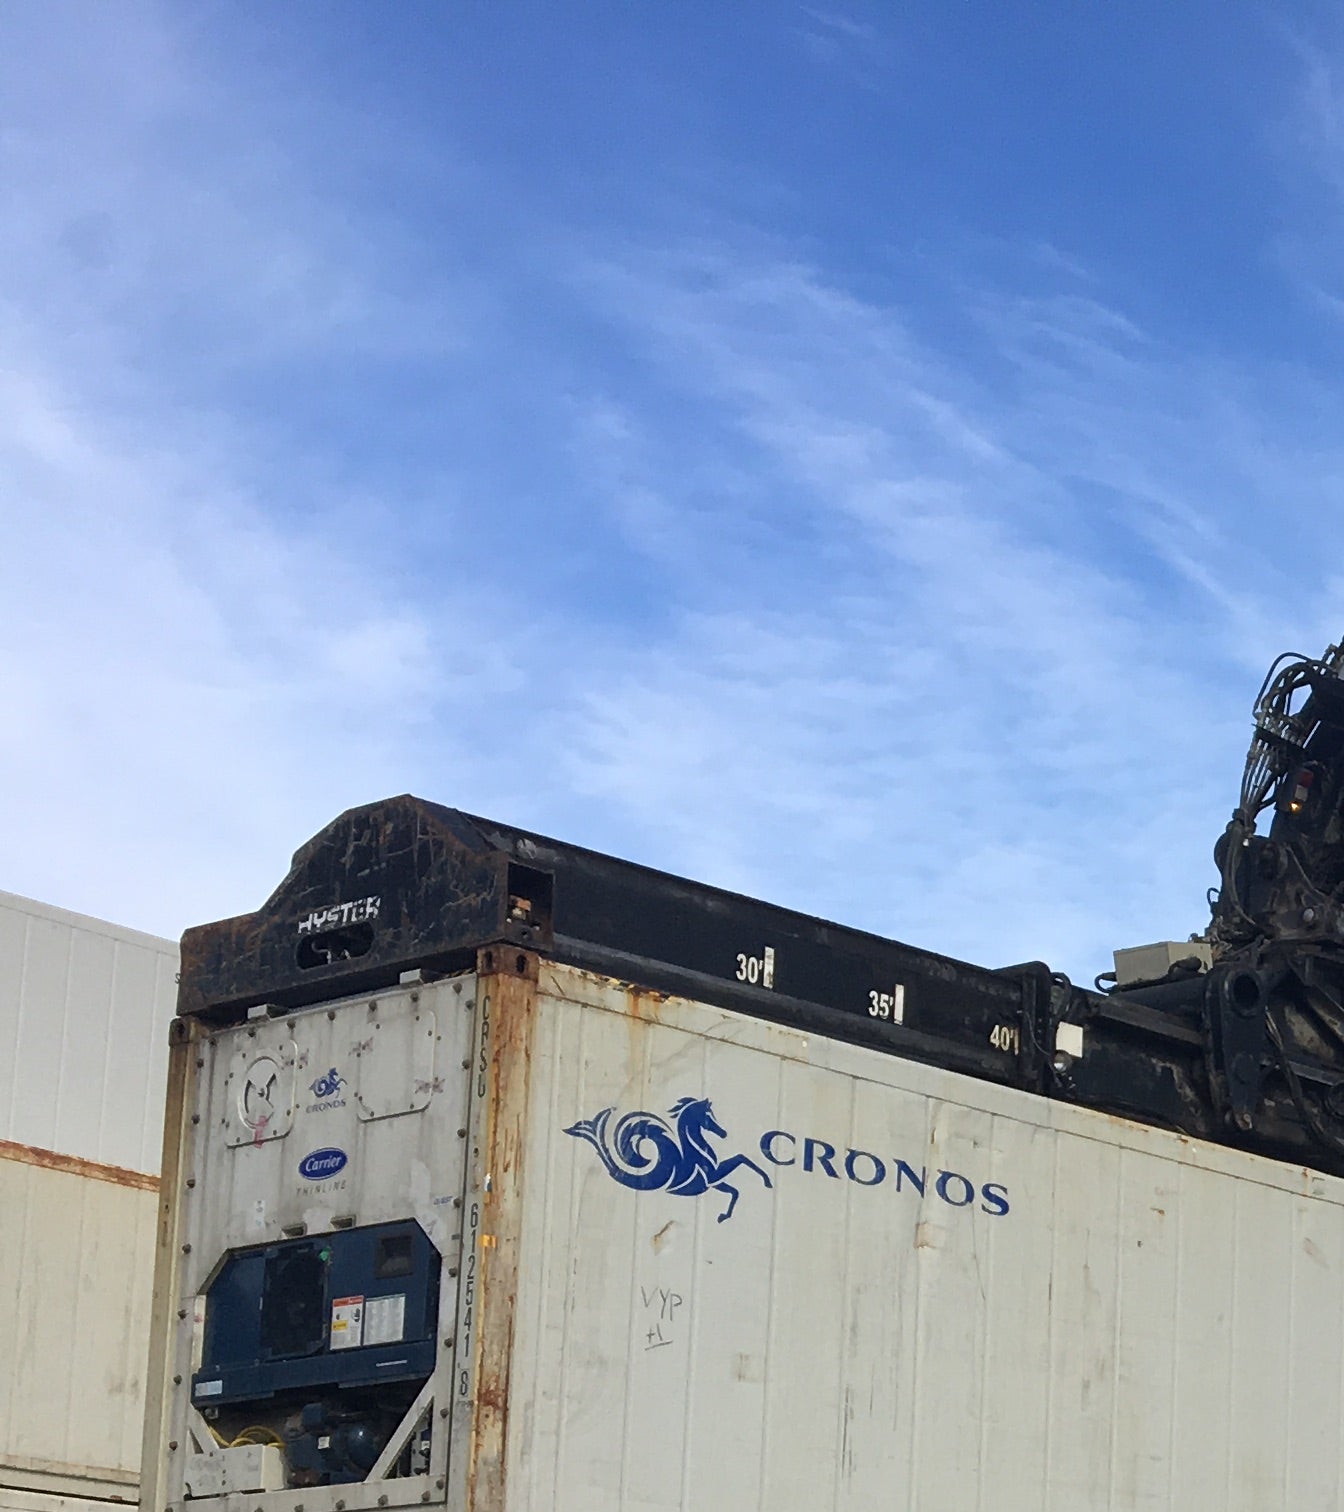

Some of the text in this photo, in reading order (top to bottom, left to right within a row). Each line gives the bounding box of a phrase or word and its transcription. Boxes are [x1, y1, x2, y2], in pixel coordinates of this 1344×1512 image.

[297, 895, 381, 934] HYSTER
[305, 1099, 347, 1114] CRONOS
[305, 1155, 342, 1172] Carrier
[759, 1129, 1010, 1217] CRONOS
